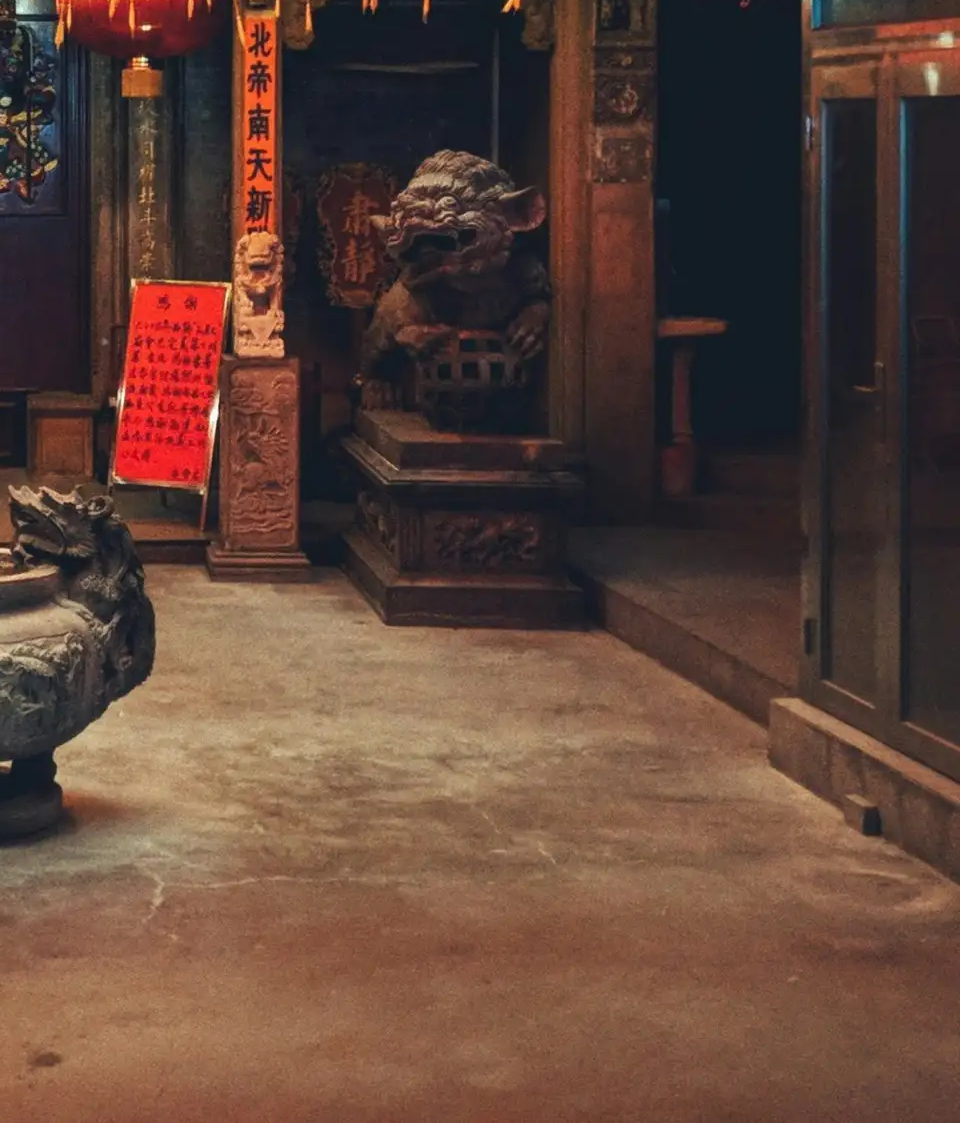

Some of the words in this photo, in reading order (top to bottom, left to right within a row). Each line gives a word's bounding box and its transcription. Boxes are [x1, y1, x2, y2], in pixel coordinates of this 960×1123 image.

[246, 21, 273, 234] 北帝南天新
[342, 189, 381, 284] 肅靜
